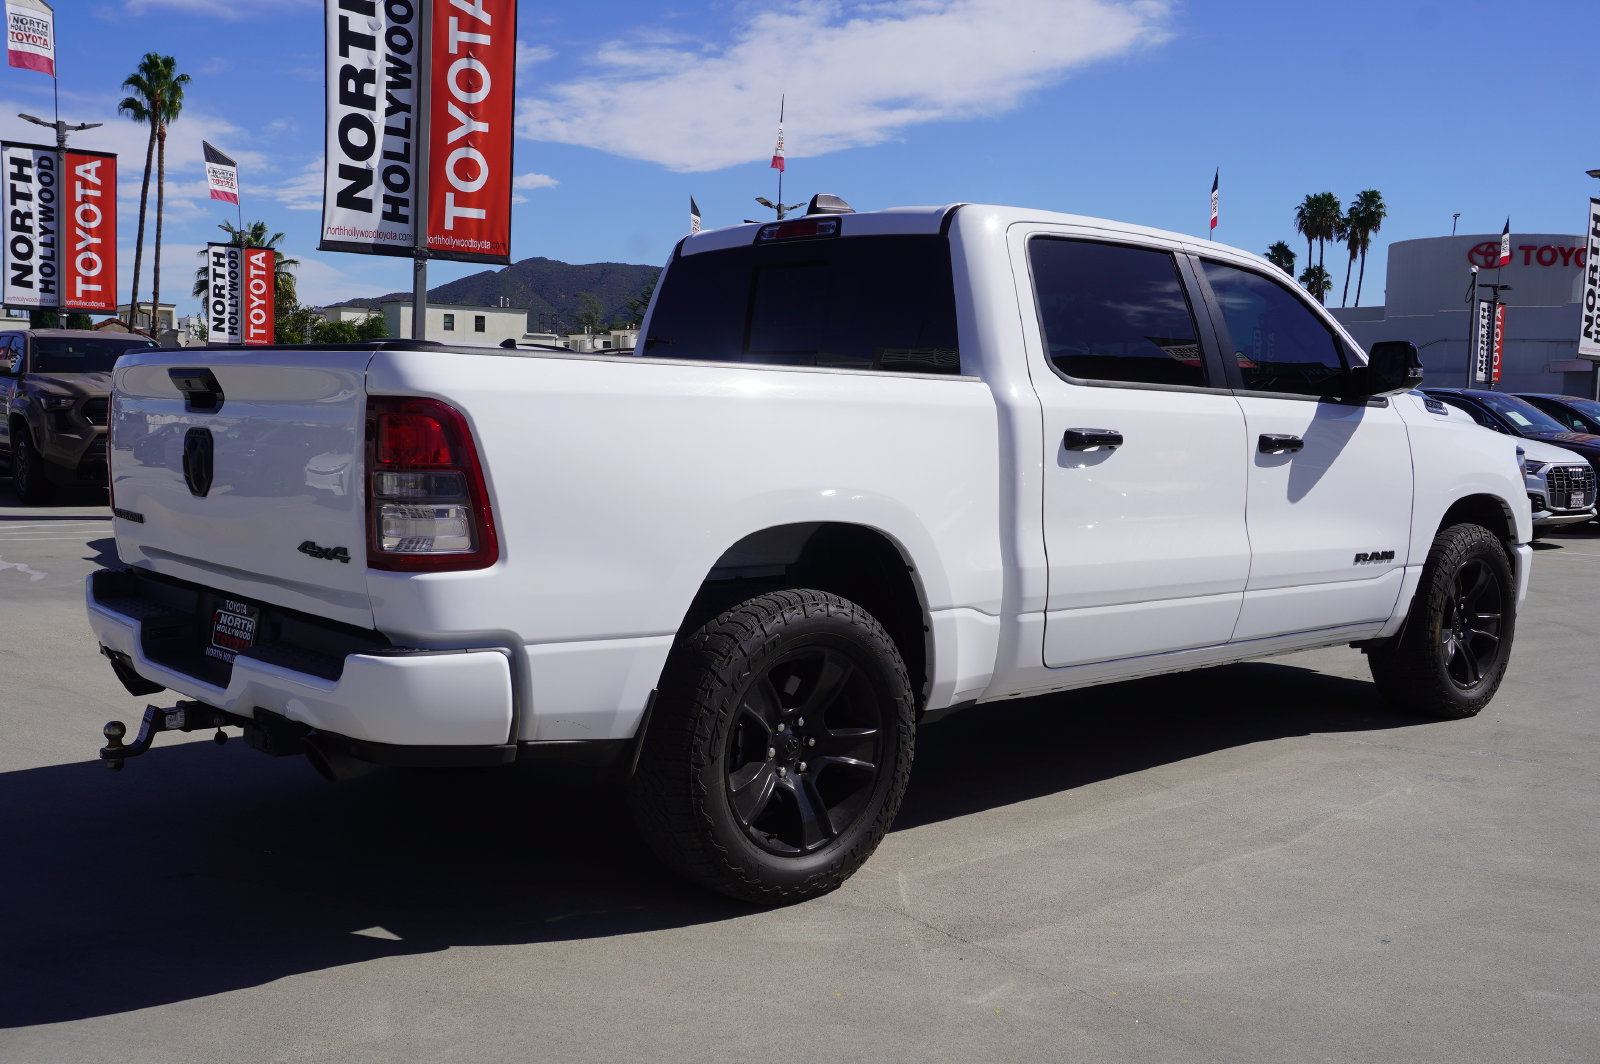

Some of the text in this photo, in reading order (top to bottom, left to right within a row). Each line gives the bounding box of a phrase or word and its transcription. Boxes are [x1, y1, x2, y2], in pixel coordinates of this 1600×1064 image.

[10, 24, 48, 37] HOLLYWOOD
[13, 16, 48, 31] NORTH
[10, 31, 49, 47] TOYOTA
[337, 0, 377, 214] NORT
[211, 178, 234, 187] TOYOTA
[9, 156, 34, 289] NORTH
[38, 155, 56, 294] HOLLYWOOD
[75, 160, 103, 297] TOYOTA
[326, 226, 413, 242] northhollywoodtoyota.com
[1583, 213, 1600, 339] NORTH
[212, 251, 226, 333] NORTH
[228, 250, 239, 336] HOLLYWOOD
[250, 251, 267, 338] TOYOTA
[1493, 306, 1502, 373] TOYOTA
[1354, 550, 1395, 563] RAM
[226, 600, 247, 614] TOYOTA
[216, 624, 251, 640] HOLLYWOOD
[220, 614, 253, 632] NORTH
[206, 647, 223, 659] NORTH
